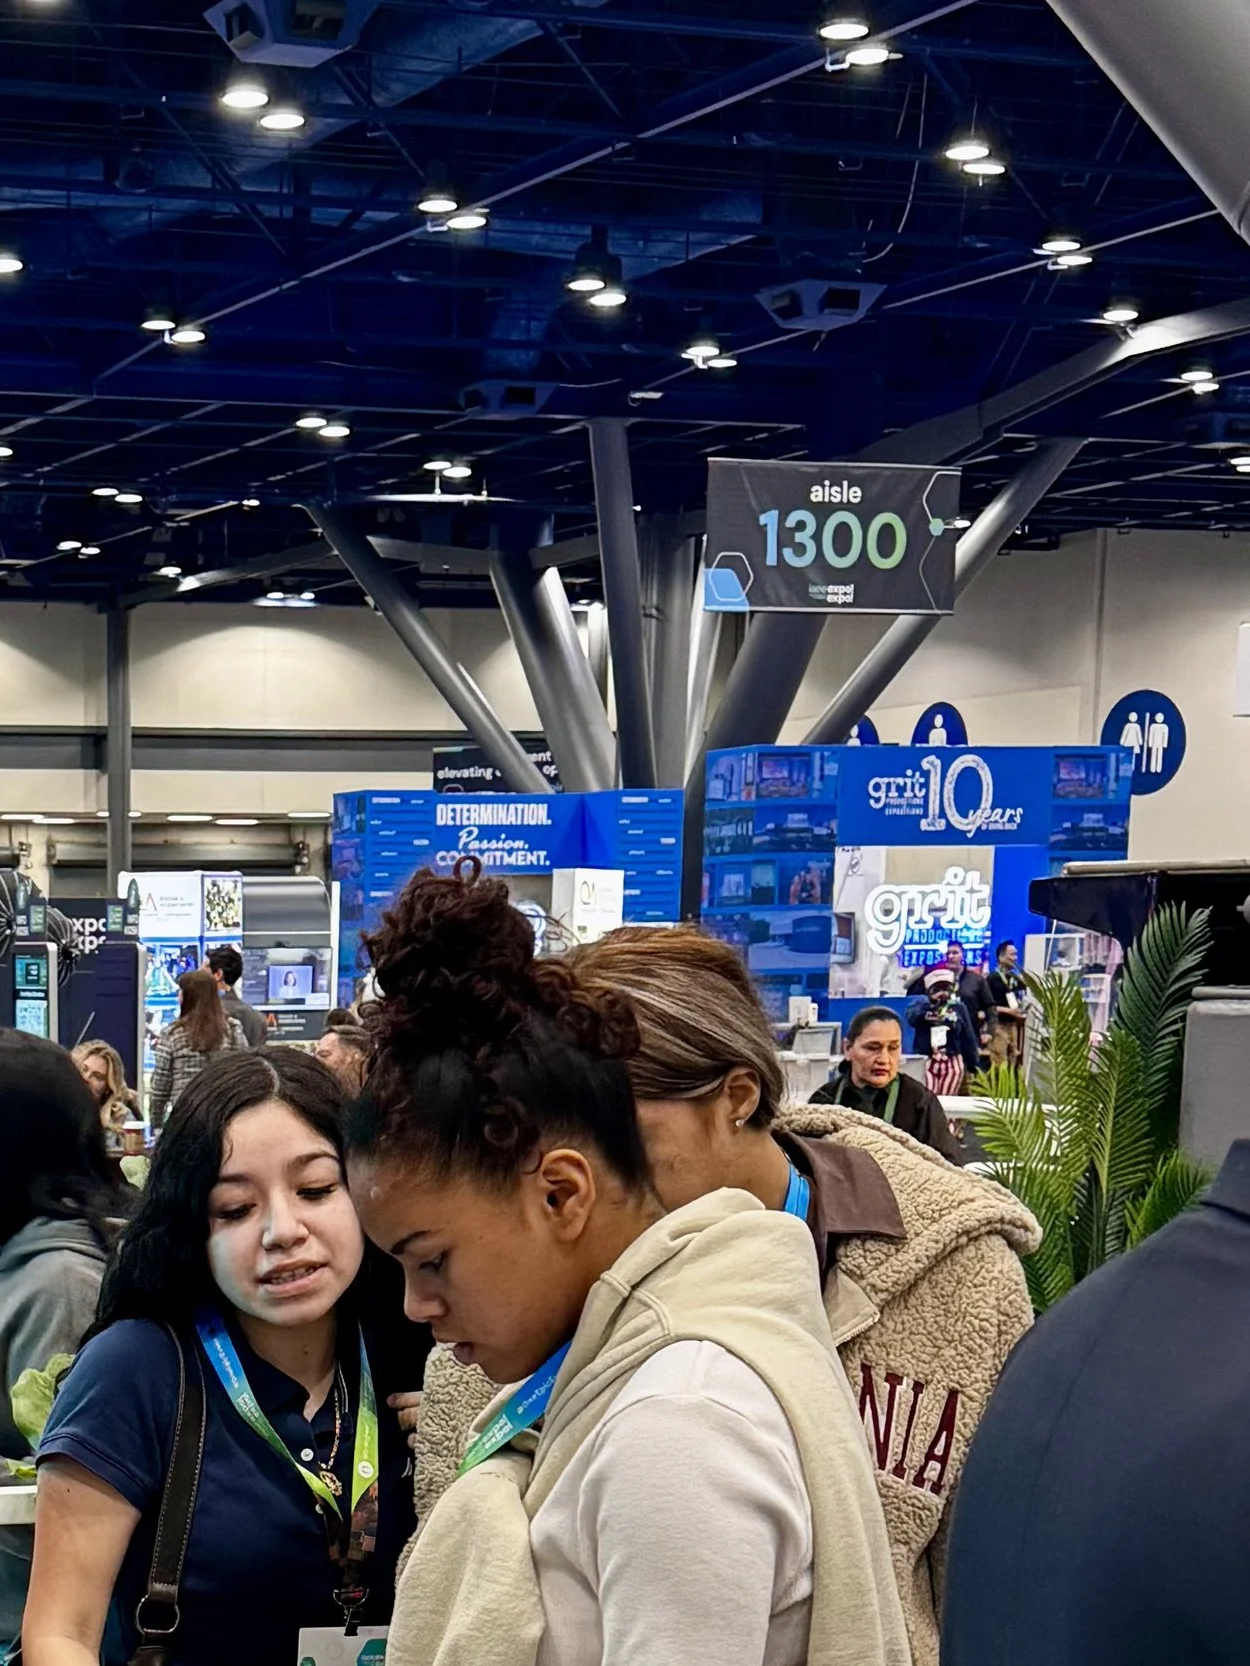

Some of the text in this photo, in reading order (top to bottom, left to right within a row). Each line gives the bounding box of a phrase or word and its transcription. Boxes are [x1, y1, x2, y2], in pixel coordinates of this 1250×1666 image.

[810, 480, 862, 503] aisle
[758, 509, 907, 569] 1300
[437, 766, 494, 781] elevating
[867, 753, 993, 831] grit 10
[436, 803, 552, 826] DETERMINATION.
[966, 807, 1023, 838] years
[458, 826, 529, 851] Passion.
[864, 866, 992, 954] grit
